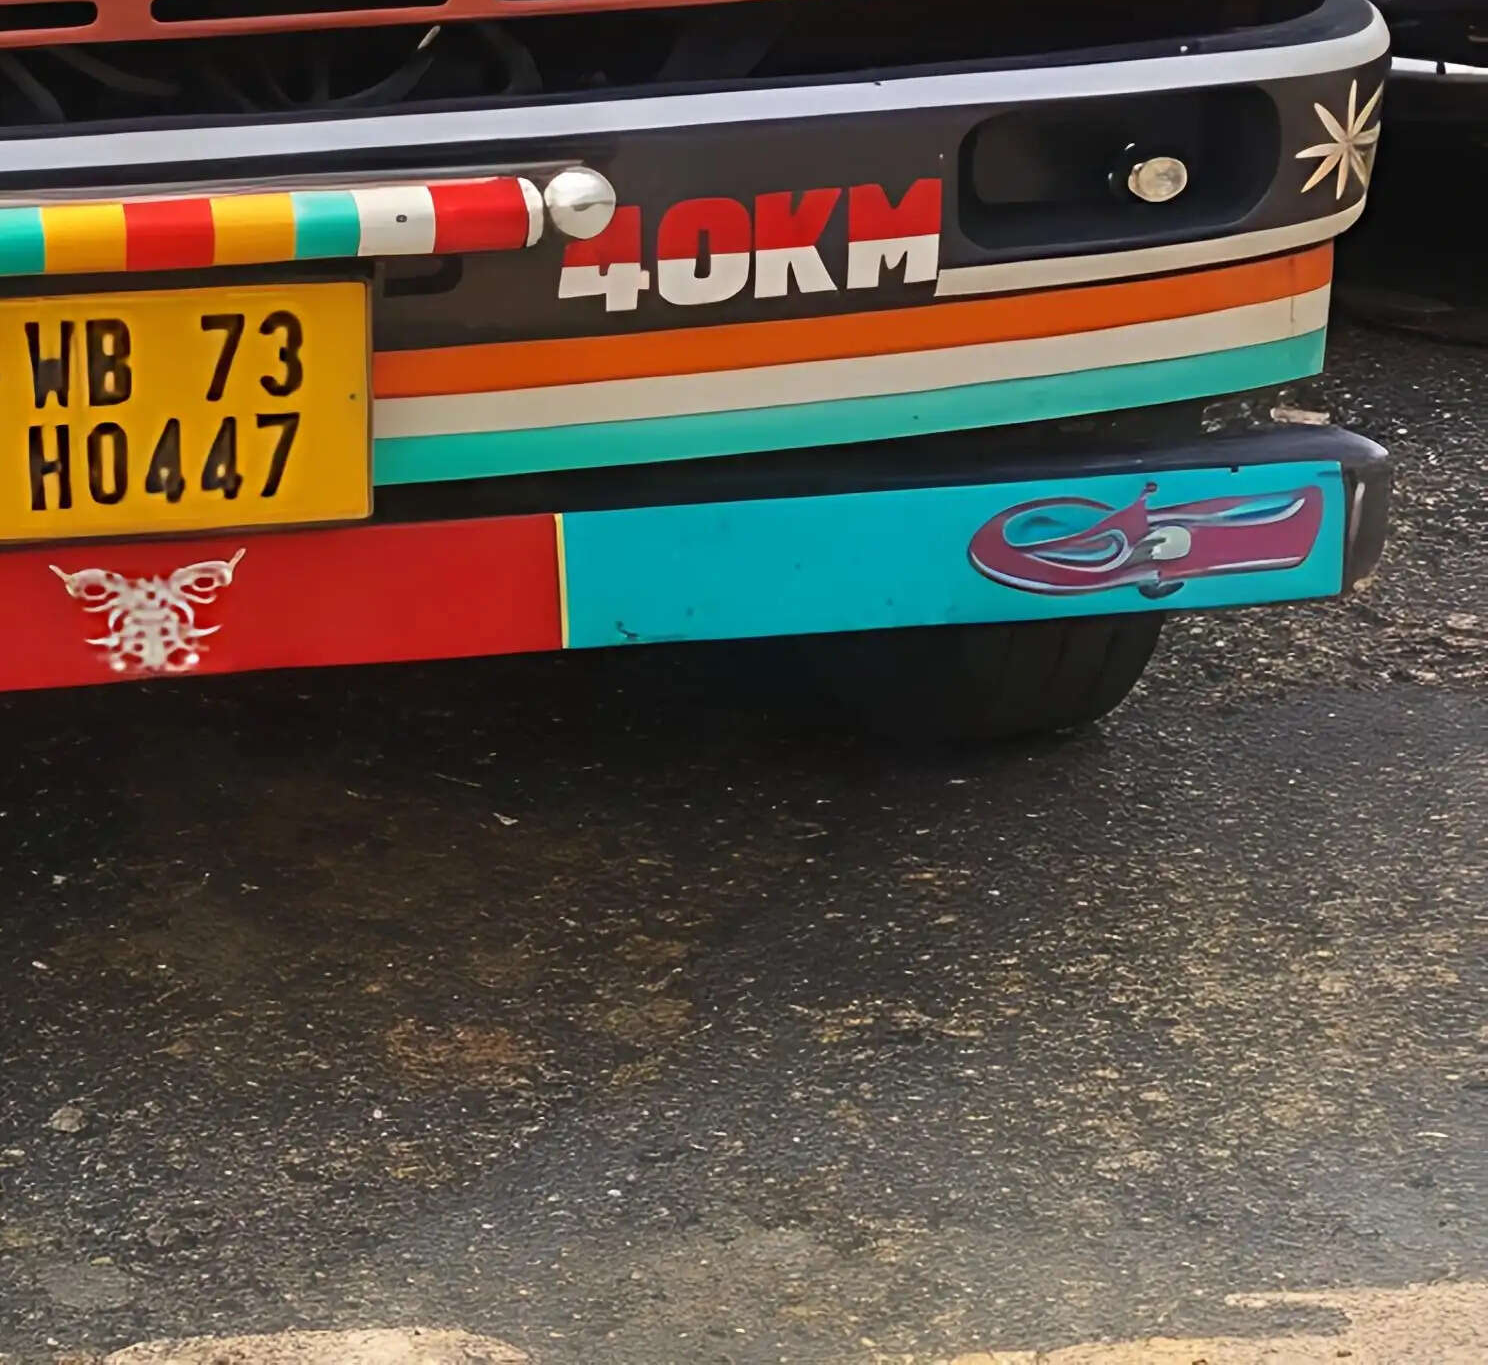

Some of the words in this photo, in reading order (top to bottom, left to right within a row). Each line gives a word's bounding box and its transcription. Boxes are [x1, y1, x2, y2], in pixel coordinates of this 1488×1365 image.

[557, 177, 943, 314] 40KM
[24, 318, 133, 409] WB
[200, 310, 304, 400] 73
[27, 412, 301, 511] H0447
